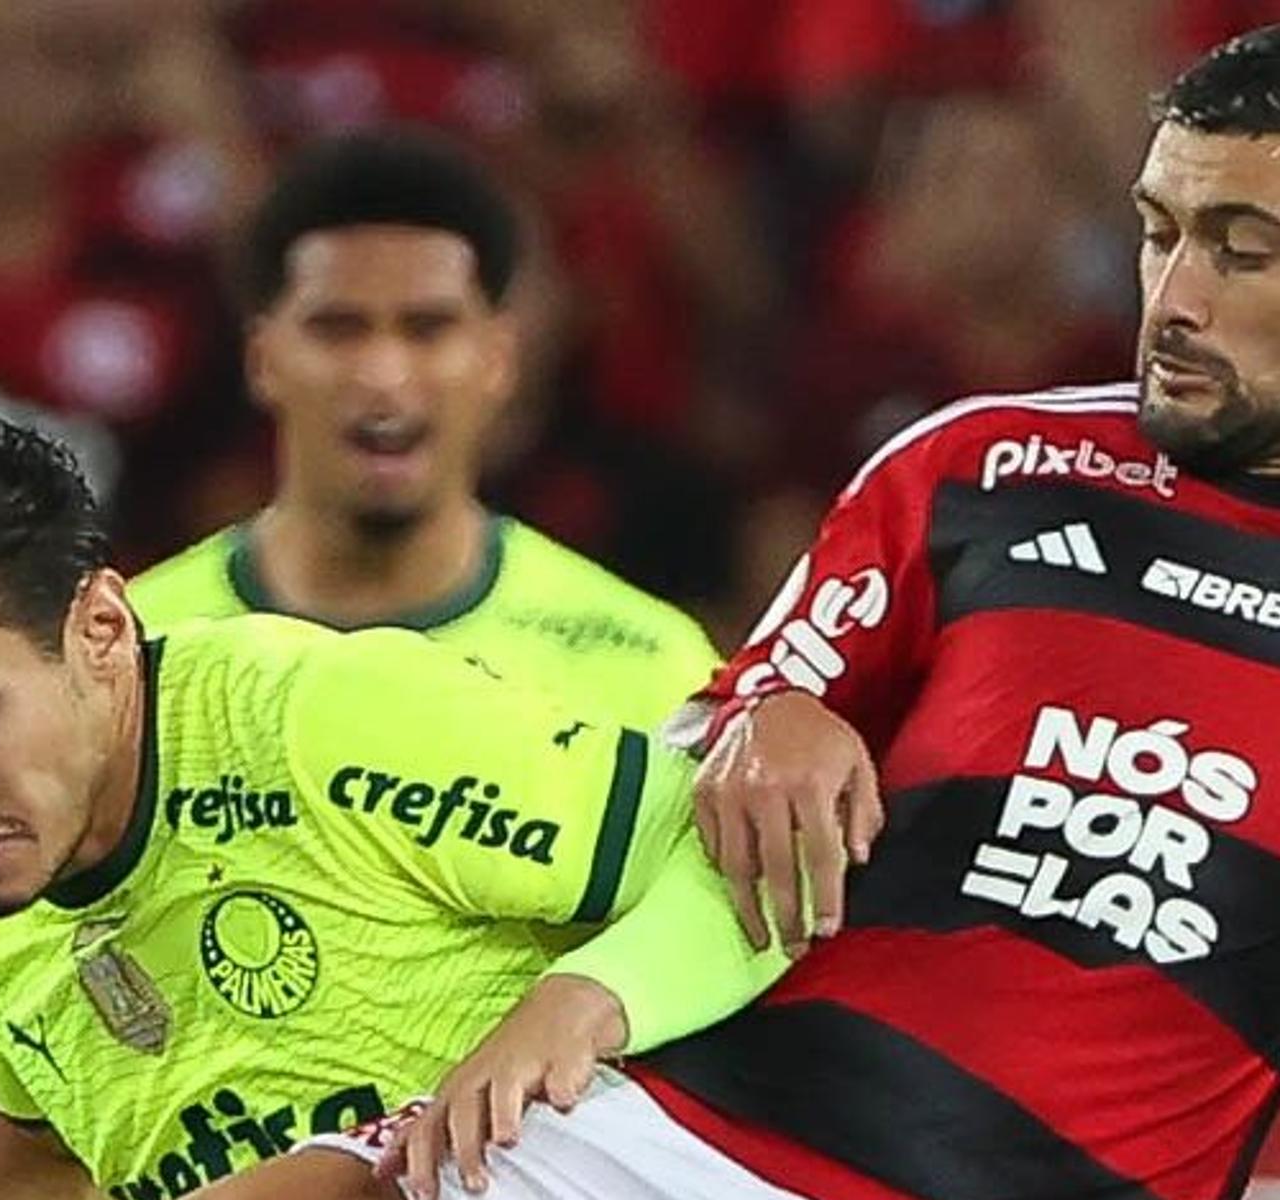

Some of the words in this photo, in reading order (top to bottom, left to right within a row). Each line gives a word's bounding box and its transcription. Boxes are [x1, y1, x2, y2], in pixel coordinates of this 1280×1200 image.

[982, 434, 1178, 498] pixbet
[1023, 705, 1258, 822] NÓS
[328, 765, 560, 865] crefisa
[996, 774, 1211, 890] POR
[207, 928, 317, 1016] PALMEIRAS
